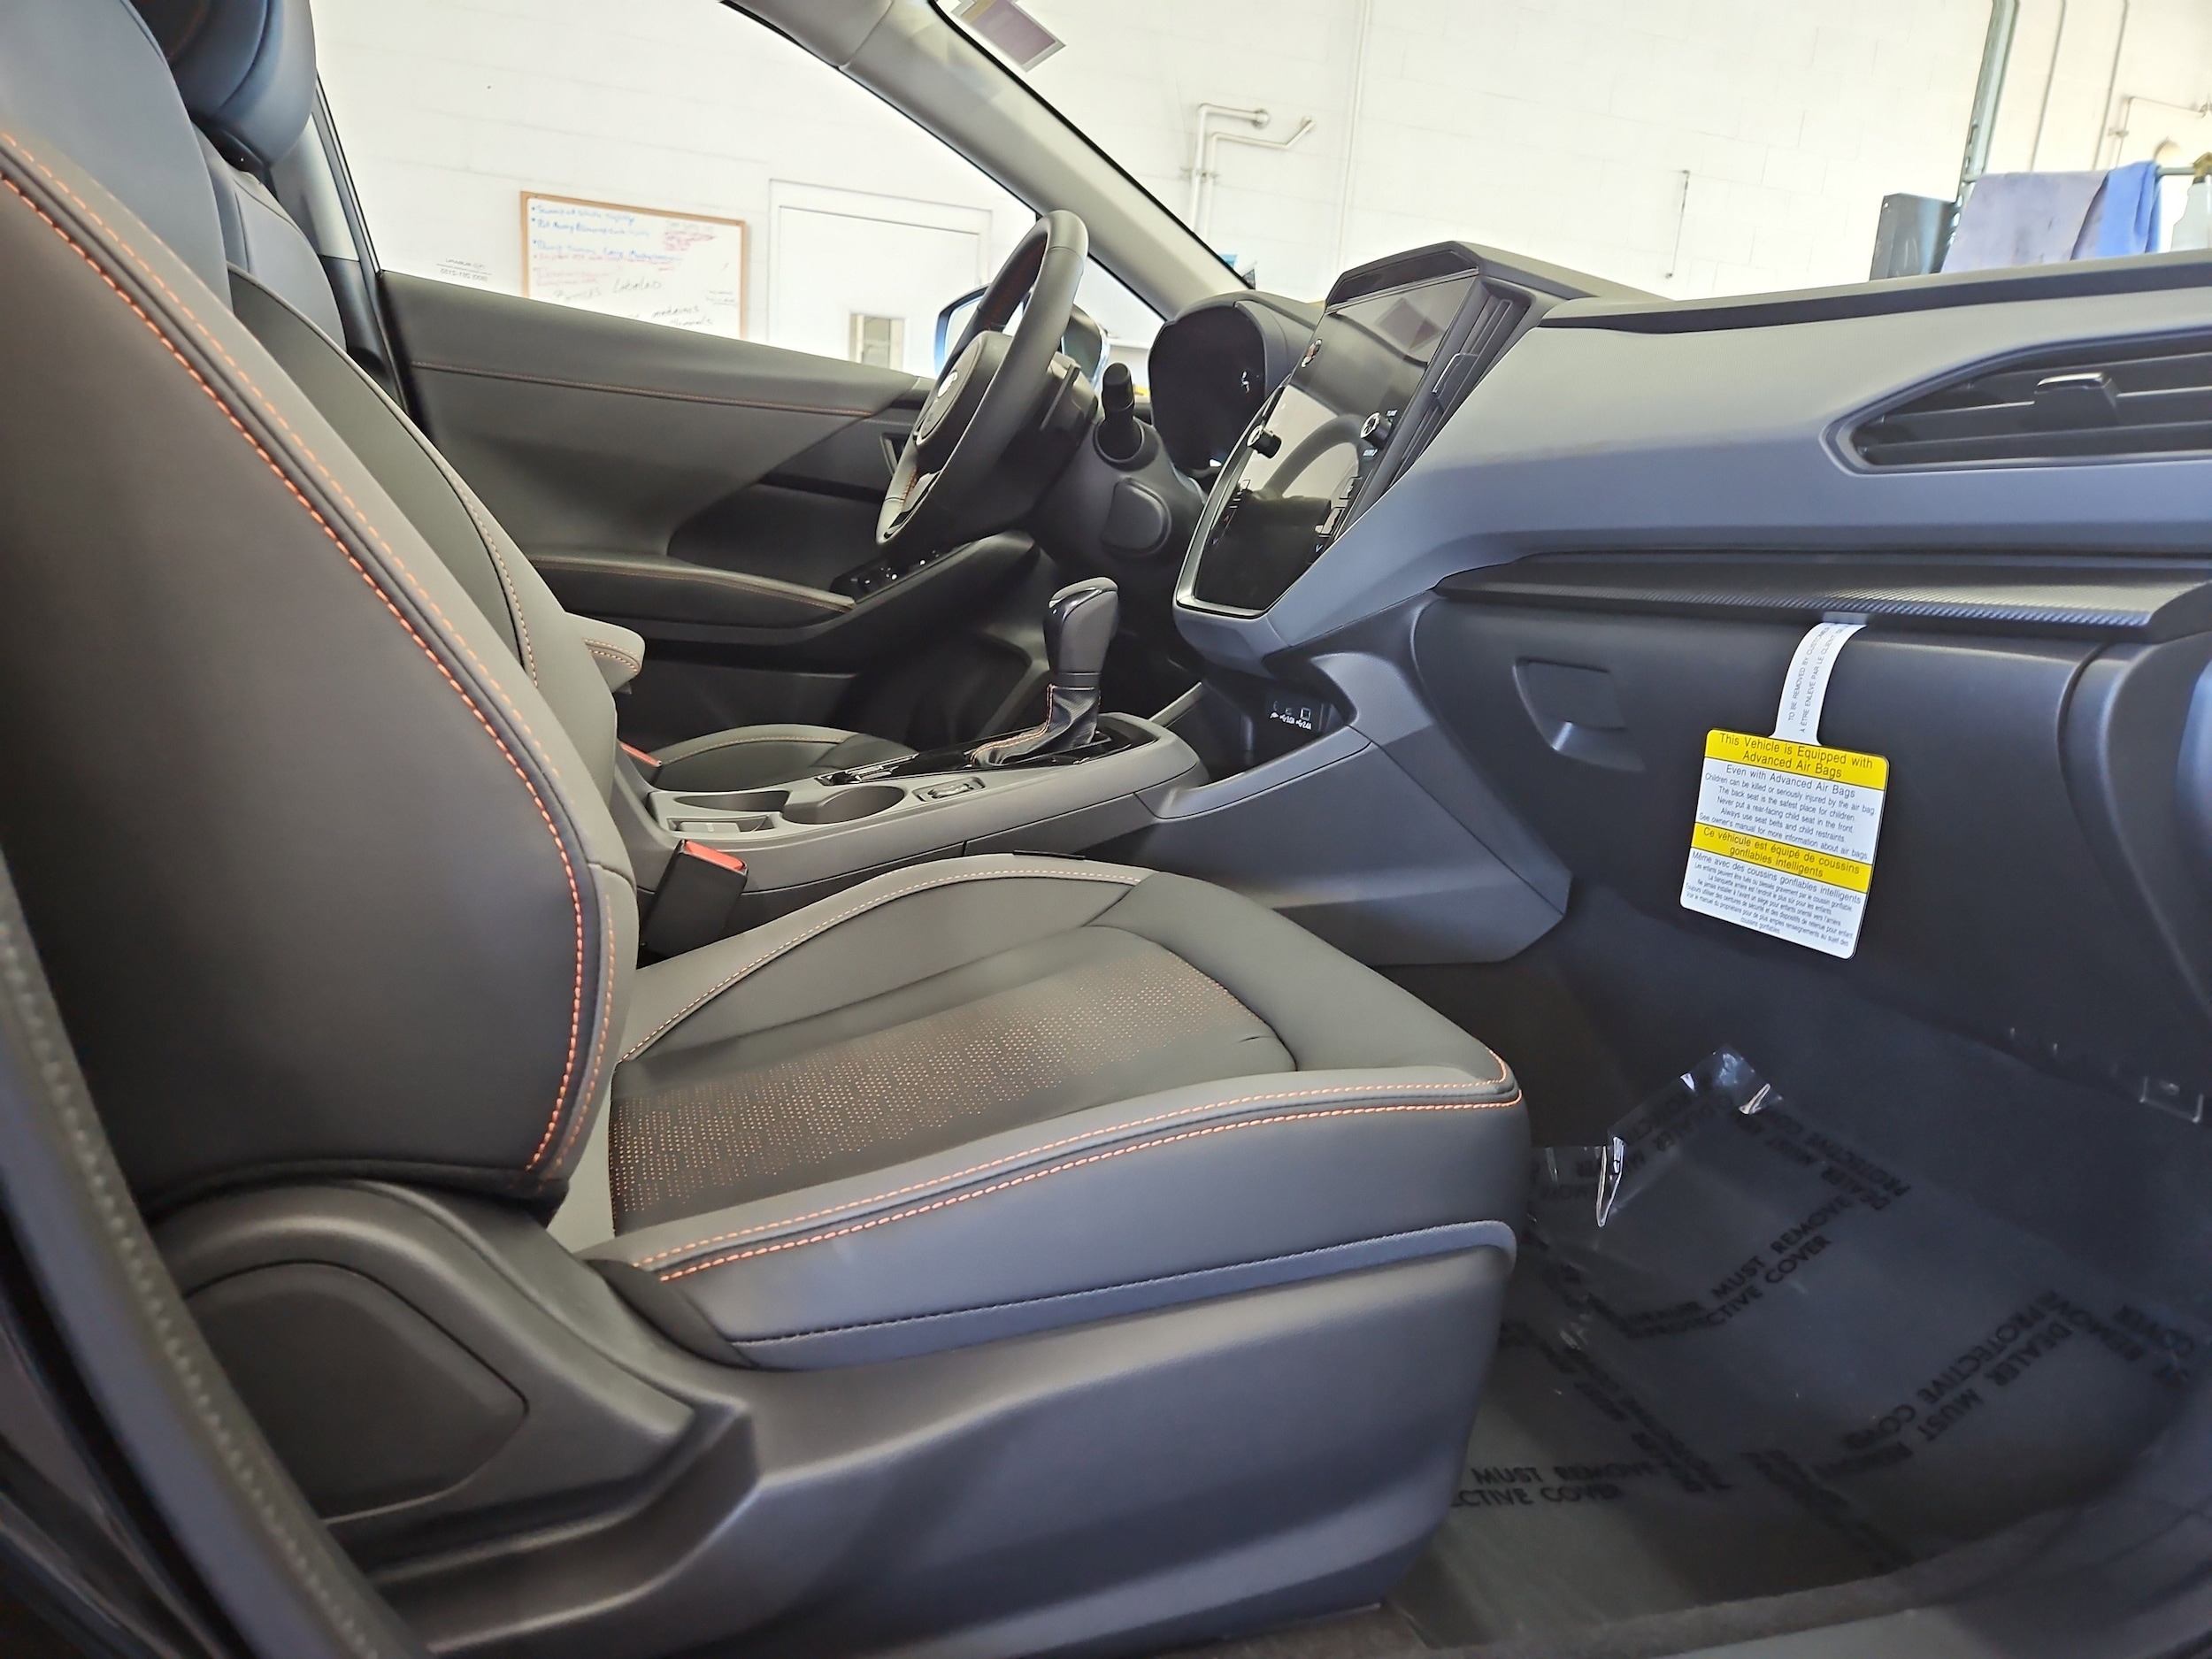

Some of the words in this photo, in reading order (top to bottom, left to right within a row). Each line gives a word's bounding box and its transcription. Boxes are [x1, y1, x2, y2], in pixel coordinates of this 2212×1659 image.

[1793, 668, 1806, 700] REMOVED
[1790, 702, 1797, 710] BE
[1718, 732, 1740, 746] This
[1743, 736, 1780, 753] Vehicle
[1784, 743, 1793, 755] is
[1796, 745, 1847, 766] Equipped
[1850, 755, 1873, 769] with
[1742, 749, 1792, 768] Advanced
[1795, 759, 1811, 772] Air
[1814, 762, 1842, 780] Bags
[1705, 772, 1727, 783] Children
[1751, 781, 1766, 791] killed
[1804, 793, 1826, 805] injured
[1827, 797, 1836, 808] by
[1838, 799, 1849, 809] the
[1850, 802, 1860, 811] air
[1725, 764, 1747, 776] Even
[1749, 768, 1766, 780] with
[1769, 772, 1812, 789] Advanced
[1815, 781, 1829, 793] Air
[1832, 784, 1855, 800] Bags
[1717, 795, 1733, 806] Never
[1735, 800, 1745, 809] put
[1752, 803, 1783, 818] rear-facing
[1785, 810, 1800, 820] child
[1801, 814, 1815, 824] seat
[1816, 818, 1824, 826] in
[1824, 819, 1835, 829] the
[1718, 786, 1729, 795] The
[1731, 788, 1745, 798] back
[1746, 792, 1759, 801] seat
[1768, 796, 1778, 805] the
[1779, 799, 1798, 810] safest
[1799, 803, 1816, 814] place
[1818, 807, 1827, 816] for
[1720, 806, 1740, 819] Always
[1755, 815, 1767, 825] seat
[1769, 818, 1783, 828] belts
[1785, 822, 1797, 831] and
[1798, 825, 1813, 835] child
[1702, 826, 1715, 837] Ce
[1717, 830, 1751, 847] véhicule
[1754, 839, 1768, 851] est
[1770, 842, 1800, 861] équipé
[1802, 851, 1816, 863] de
[1818, 855, 1861, 874] coussins
[1784, 833, 1818, 848] information
[1820, 841, 1839, 853] about
[1729, 844, 1772, 866] gonflables
[1775, 856, 1824, 879] intelligents
[1714, 857, 1730, 868] avec
[1732, 861, 1745, 872] des
[1747, 865, 1778, 881] coussins
[1779, 874, 1817, 895] gonflables
[1819, 885, 1862, 906] intelligents
[1764, 1234, 1832, 1284] COVER
[1711, 1255, 1767, 1301] MUST
[1983, 1323, 2072, 1388] DEALER
[1916, 1388, 1983, 1443] MUST
[1471, 1466, 1543, 1485] MUST
[1452, 1488, 1533, 1507] CTIVE
